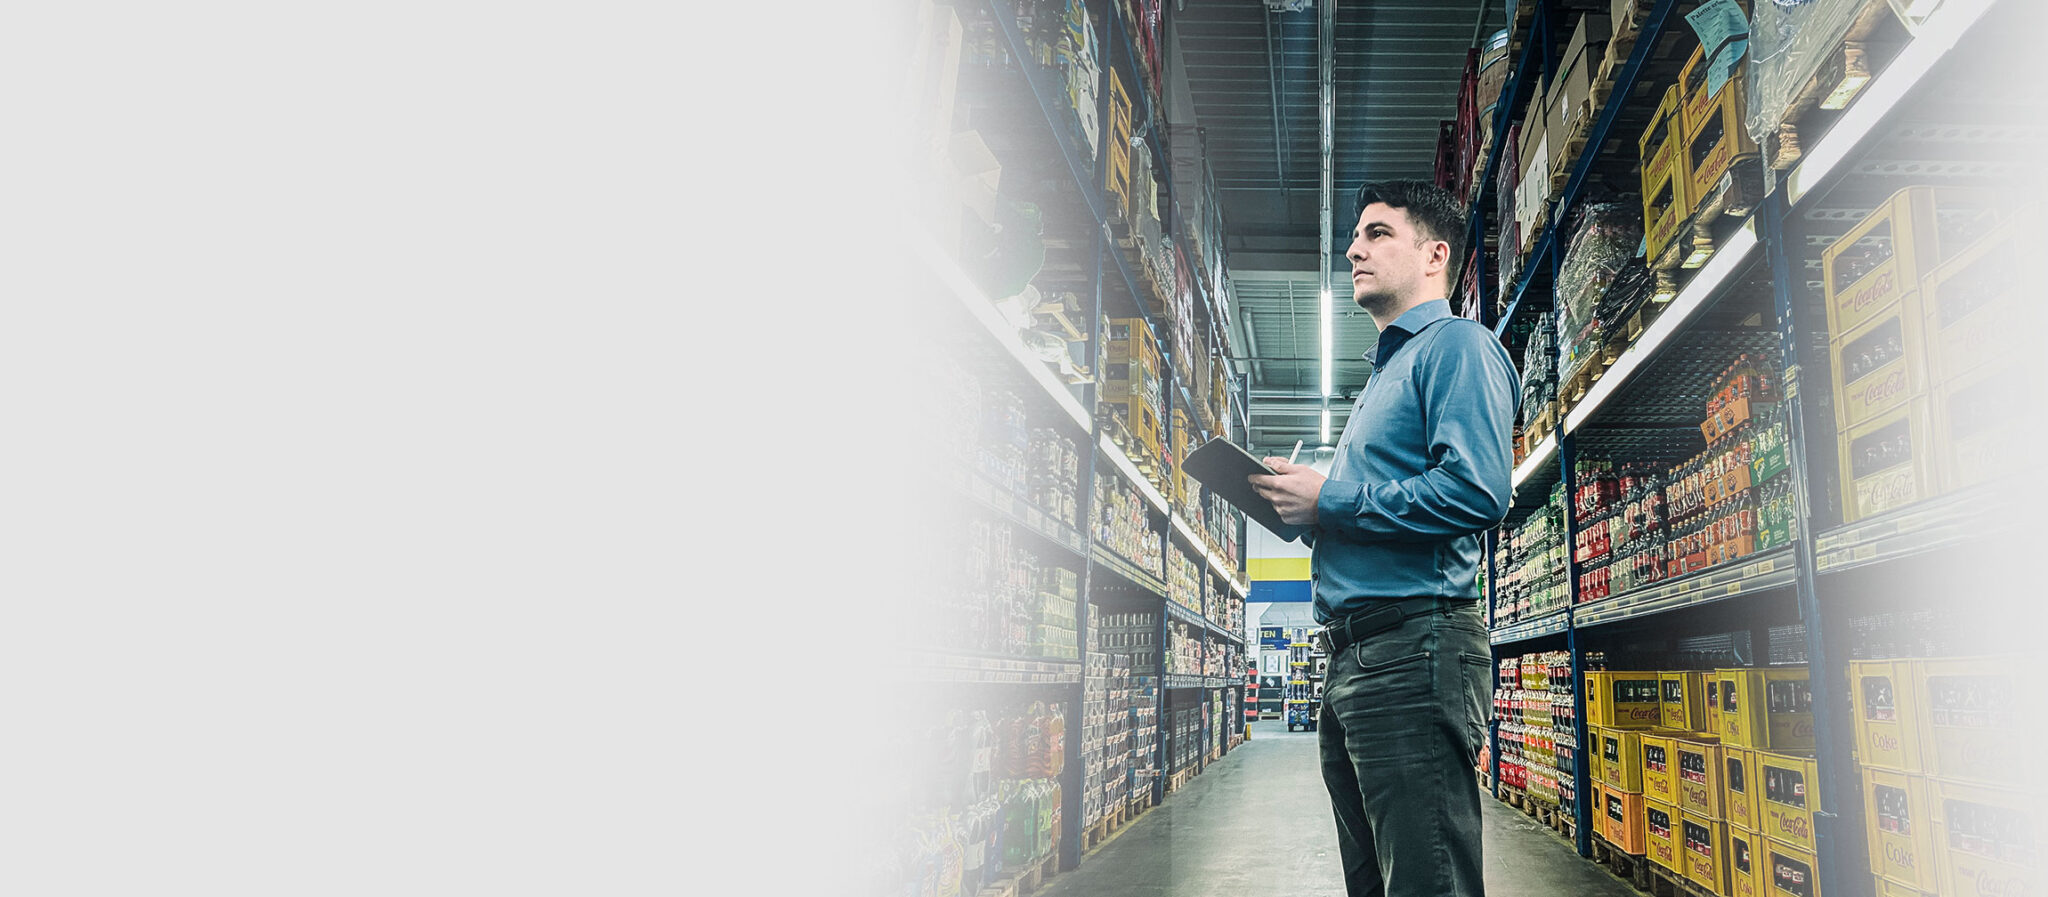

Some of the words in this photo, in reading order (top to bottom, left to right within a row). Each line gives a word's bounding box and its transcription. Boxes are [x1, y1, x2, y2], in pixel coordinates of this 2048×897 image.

[1854, 269, 1894, 313] Coca-Cola
[1872, 732, 1898, 751] Coke
[1780, 811, 1808, 839] Coca-Cola
[1885, 842, 1914, 869] Coke
